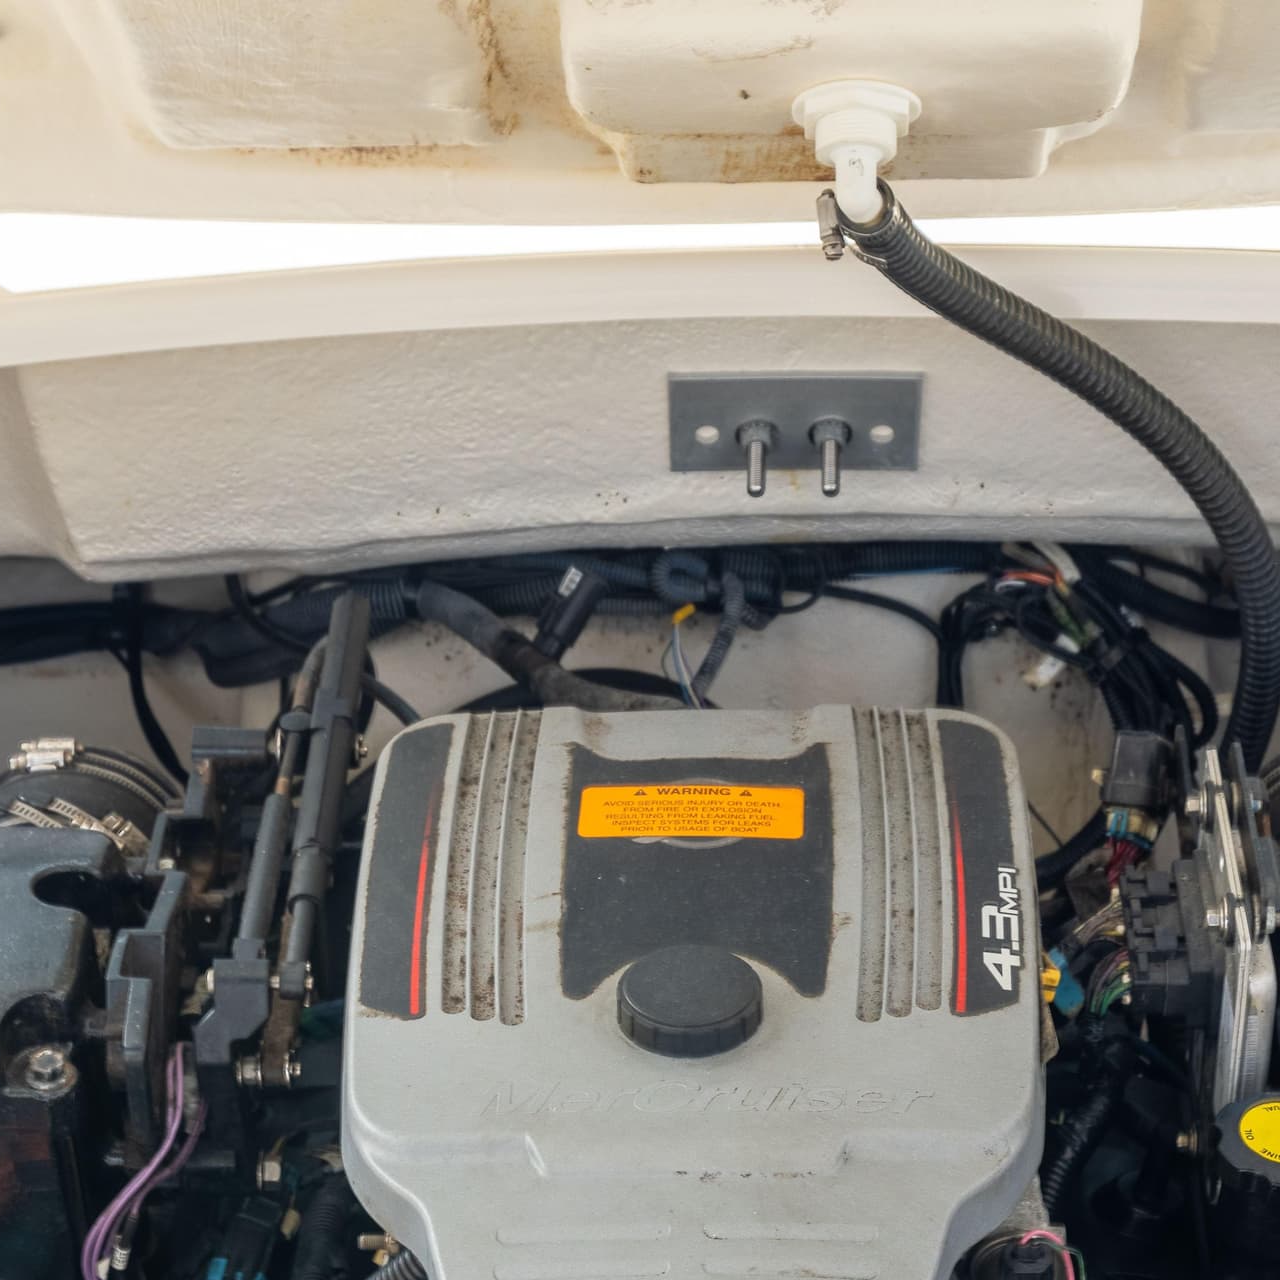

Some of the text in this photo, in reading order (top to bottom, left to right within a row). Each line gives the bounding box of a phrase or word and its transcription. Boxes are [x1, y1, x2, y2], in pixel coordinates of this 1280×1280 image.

[656, 787, 731, 797] WARNING
[479, 1079, 937, 1116] MerCruiser
[1244, 1128, 1255, 1141] OIL
